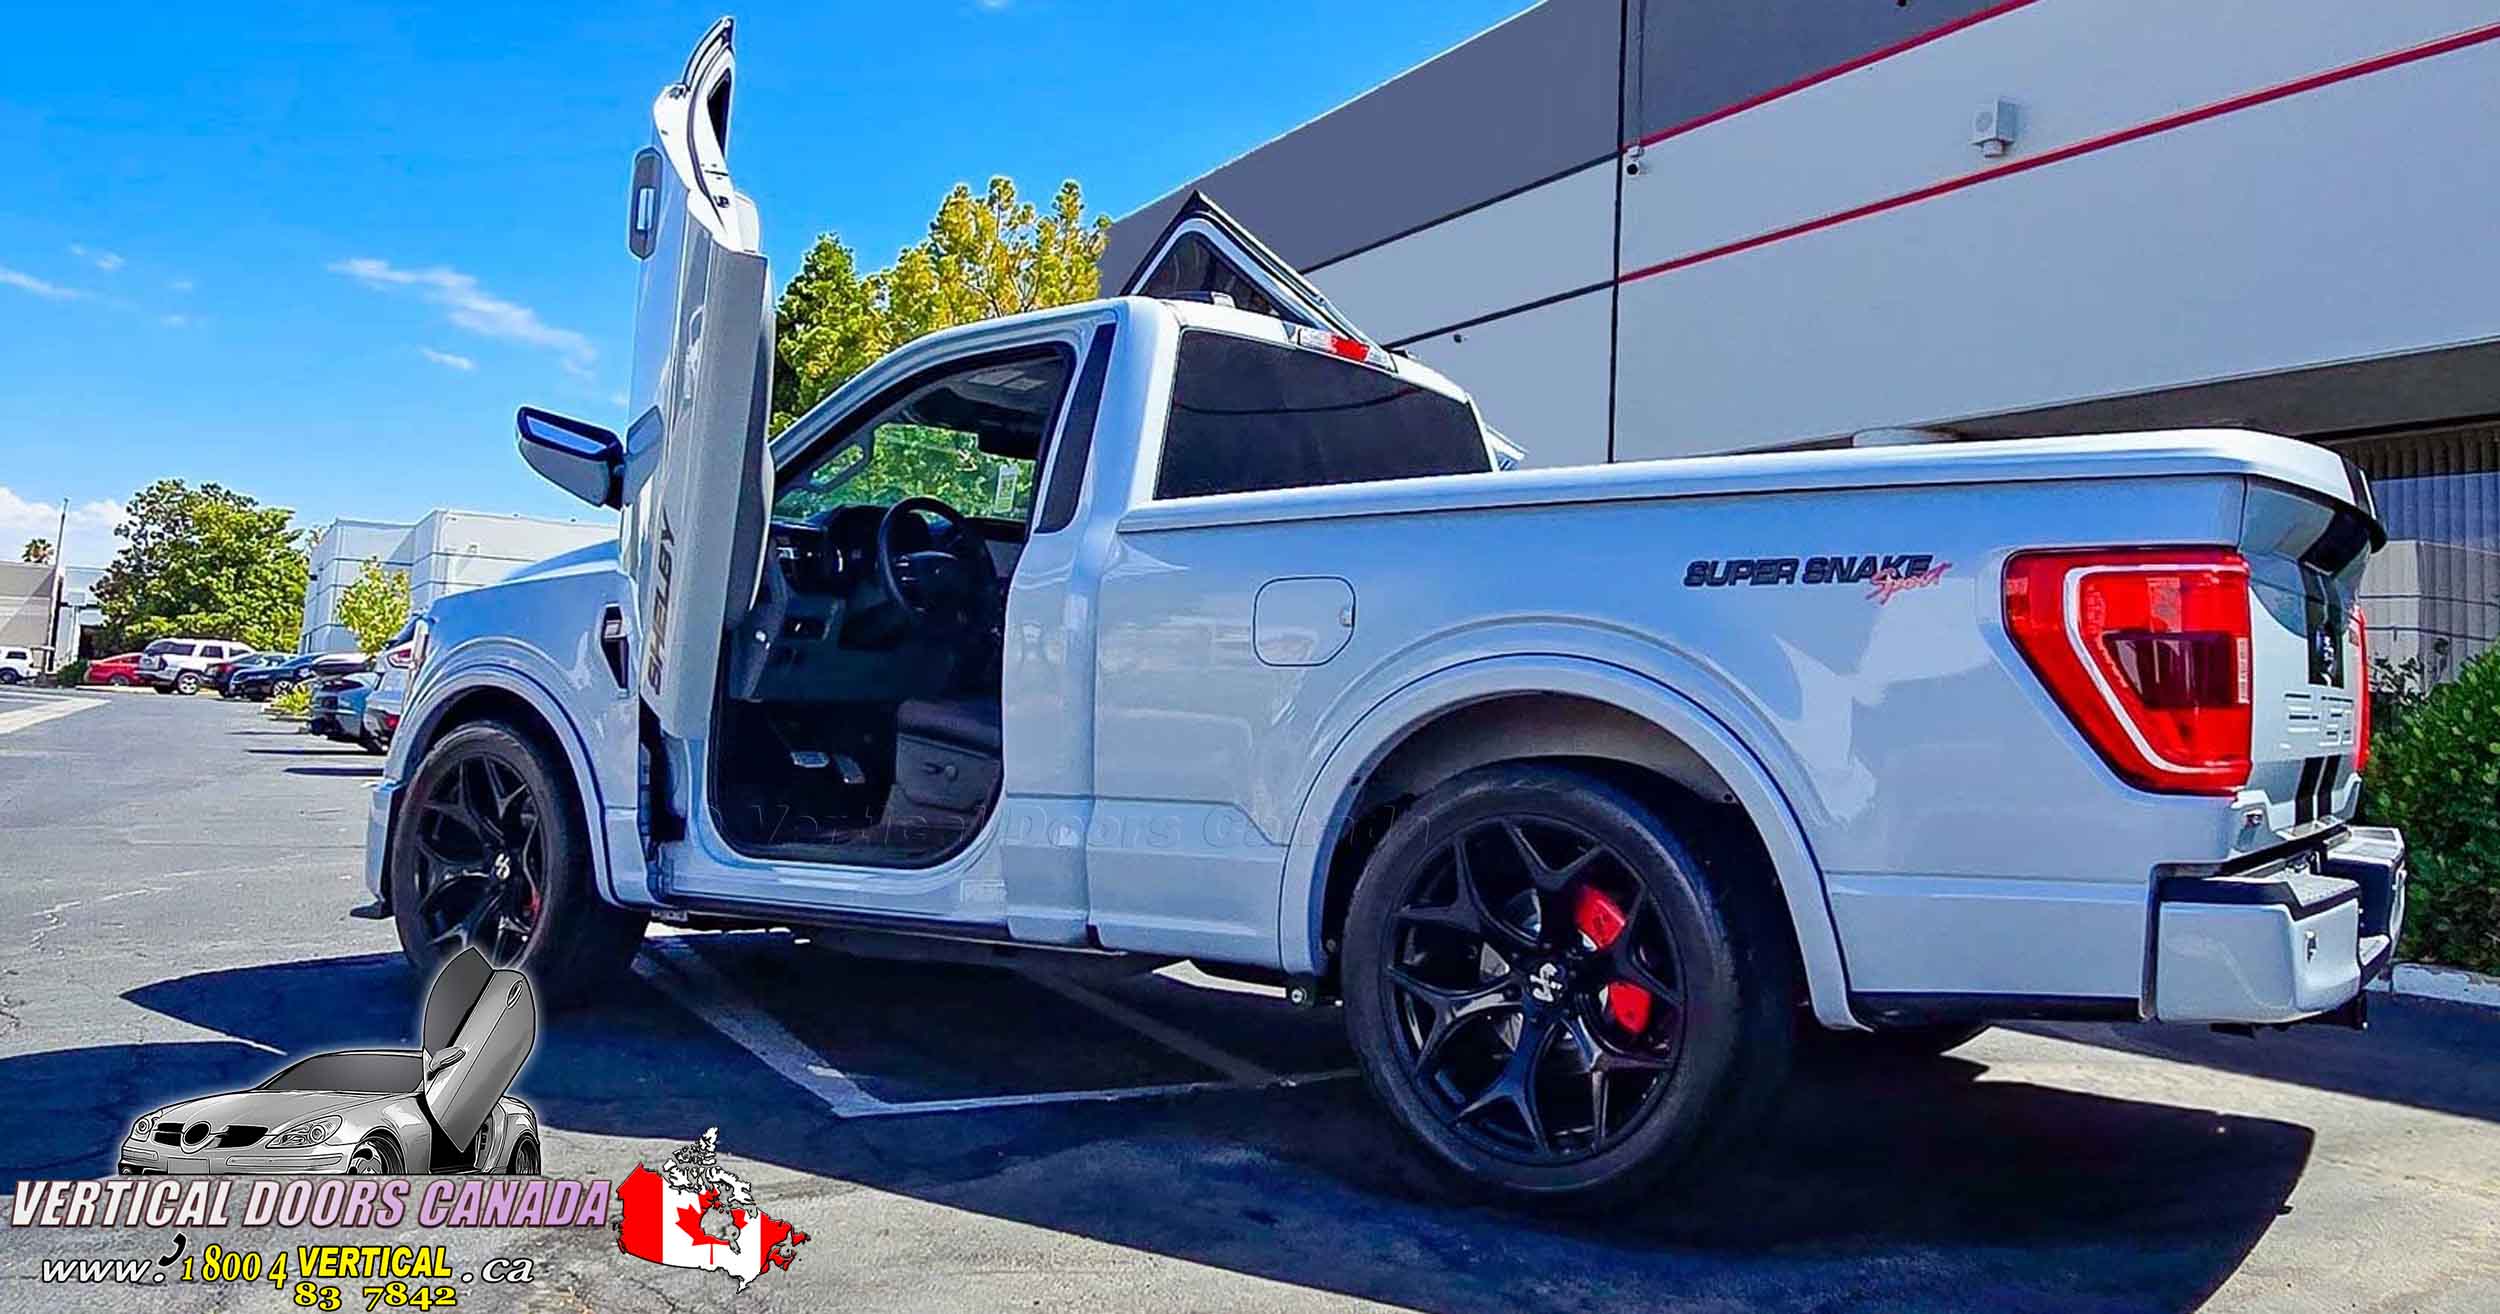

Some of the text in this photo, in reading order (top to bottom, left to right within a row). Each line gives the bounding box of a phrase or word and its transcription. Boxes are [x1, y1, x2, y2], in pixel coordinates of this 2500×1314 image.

[1684, 555, 1932, 586] SUPER SNAKE
[1865, 562, 1951, 605] Sport
[647, 508, 676, 696] SHELBY
